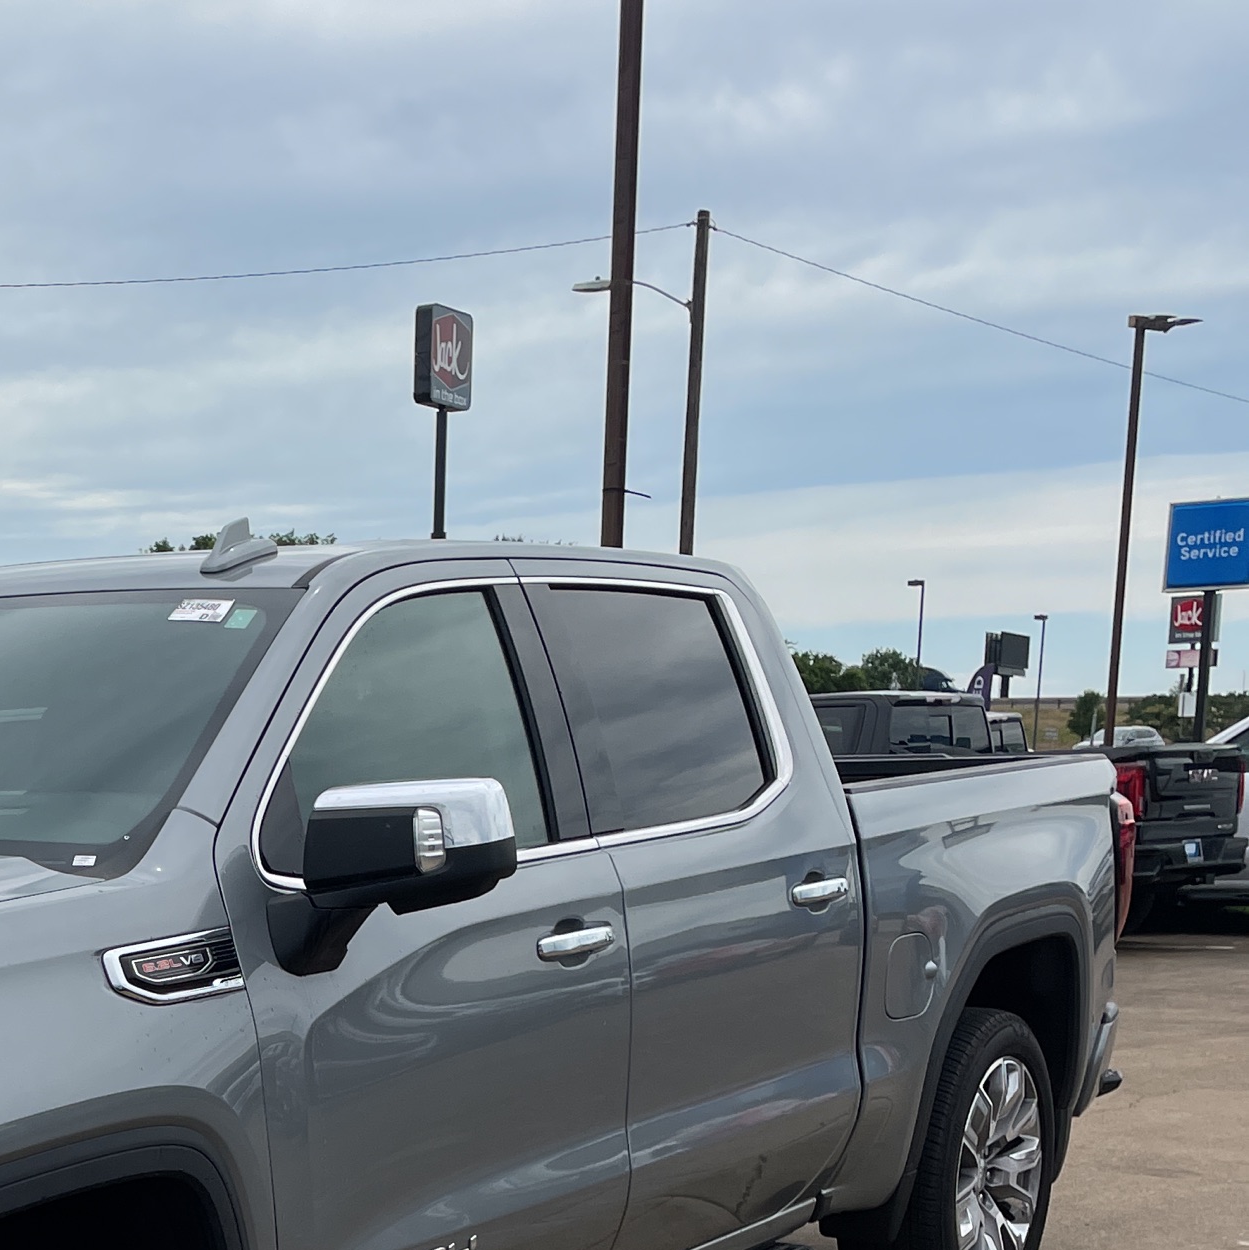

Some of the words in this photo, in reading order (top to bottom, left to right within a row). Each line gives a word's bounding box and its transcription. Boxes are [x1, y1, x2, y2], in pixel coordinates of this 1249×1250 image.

[432, 322, 470, 380] Jack
[1176, 527, 1245, 546] Certified
[1180, 545, 1239, 560] Service
[1173, 600, 1203, 627] Jack
